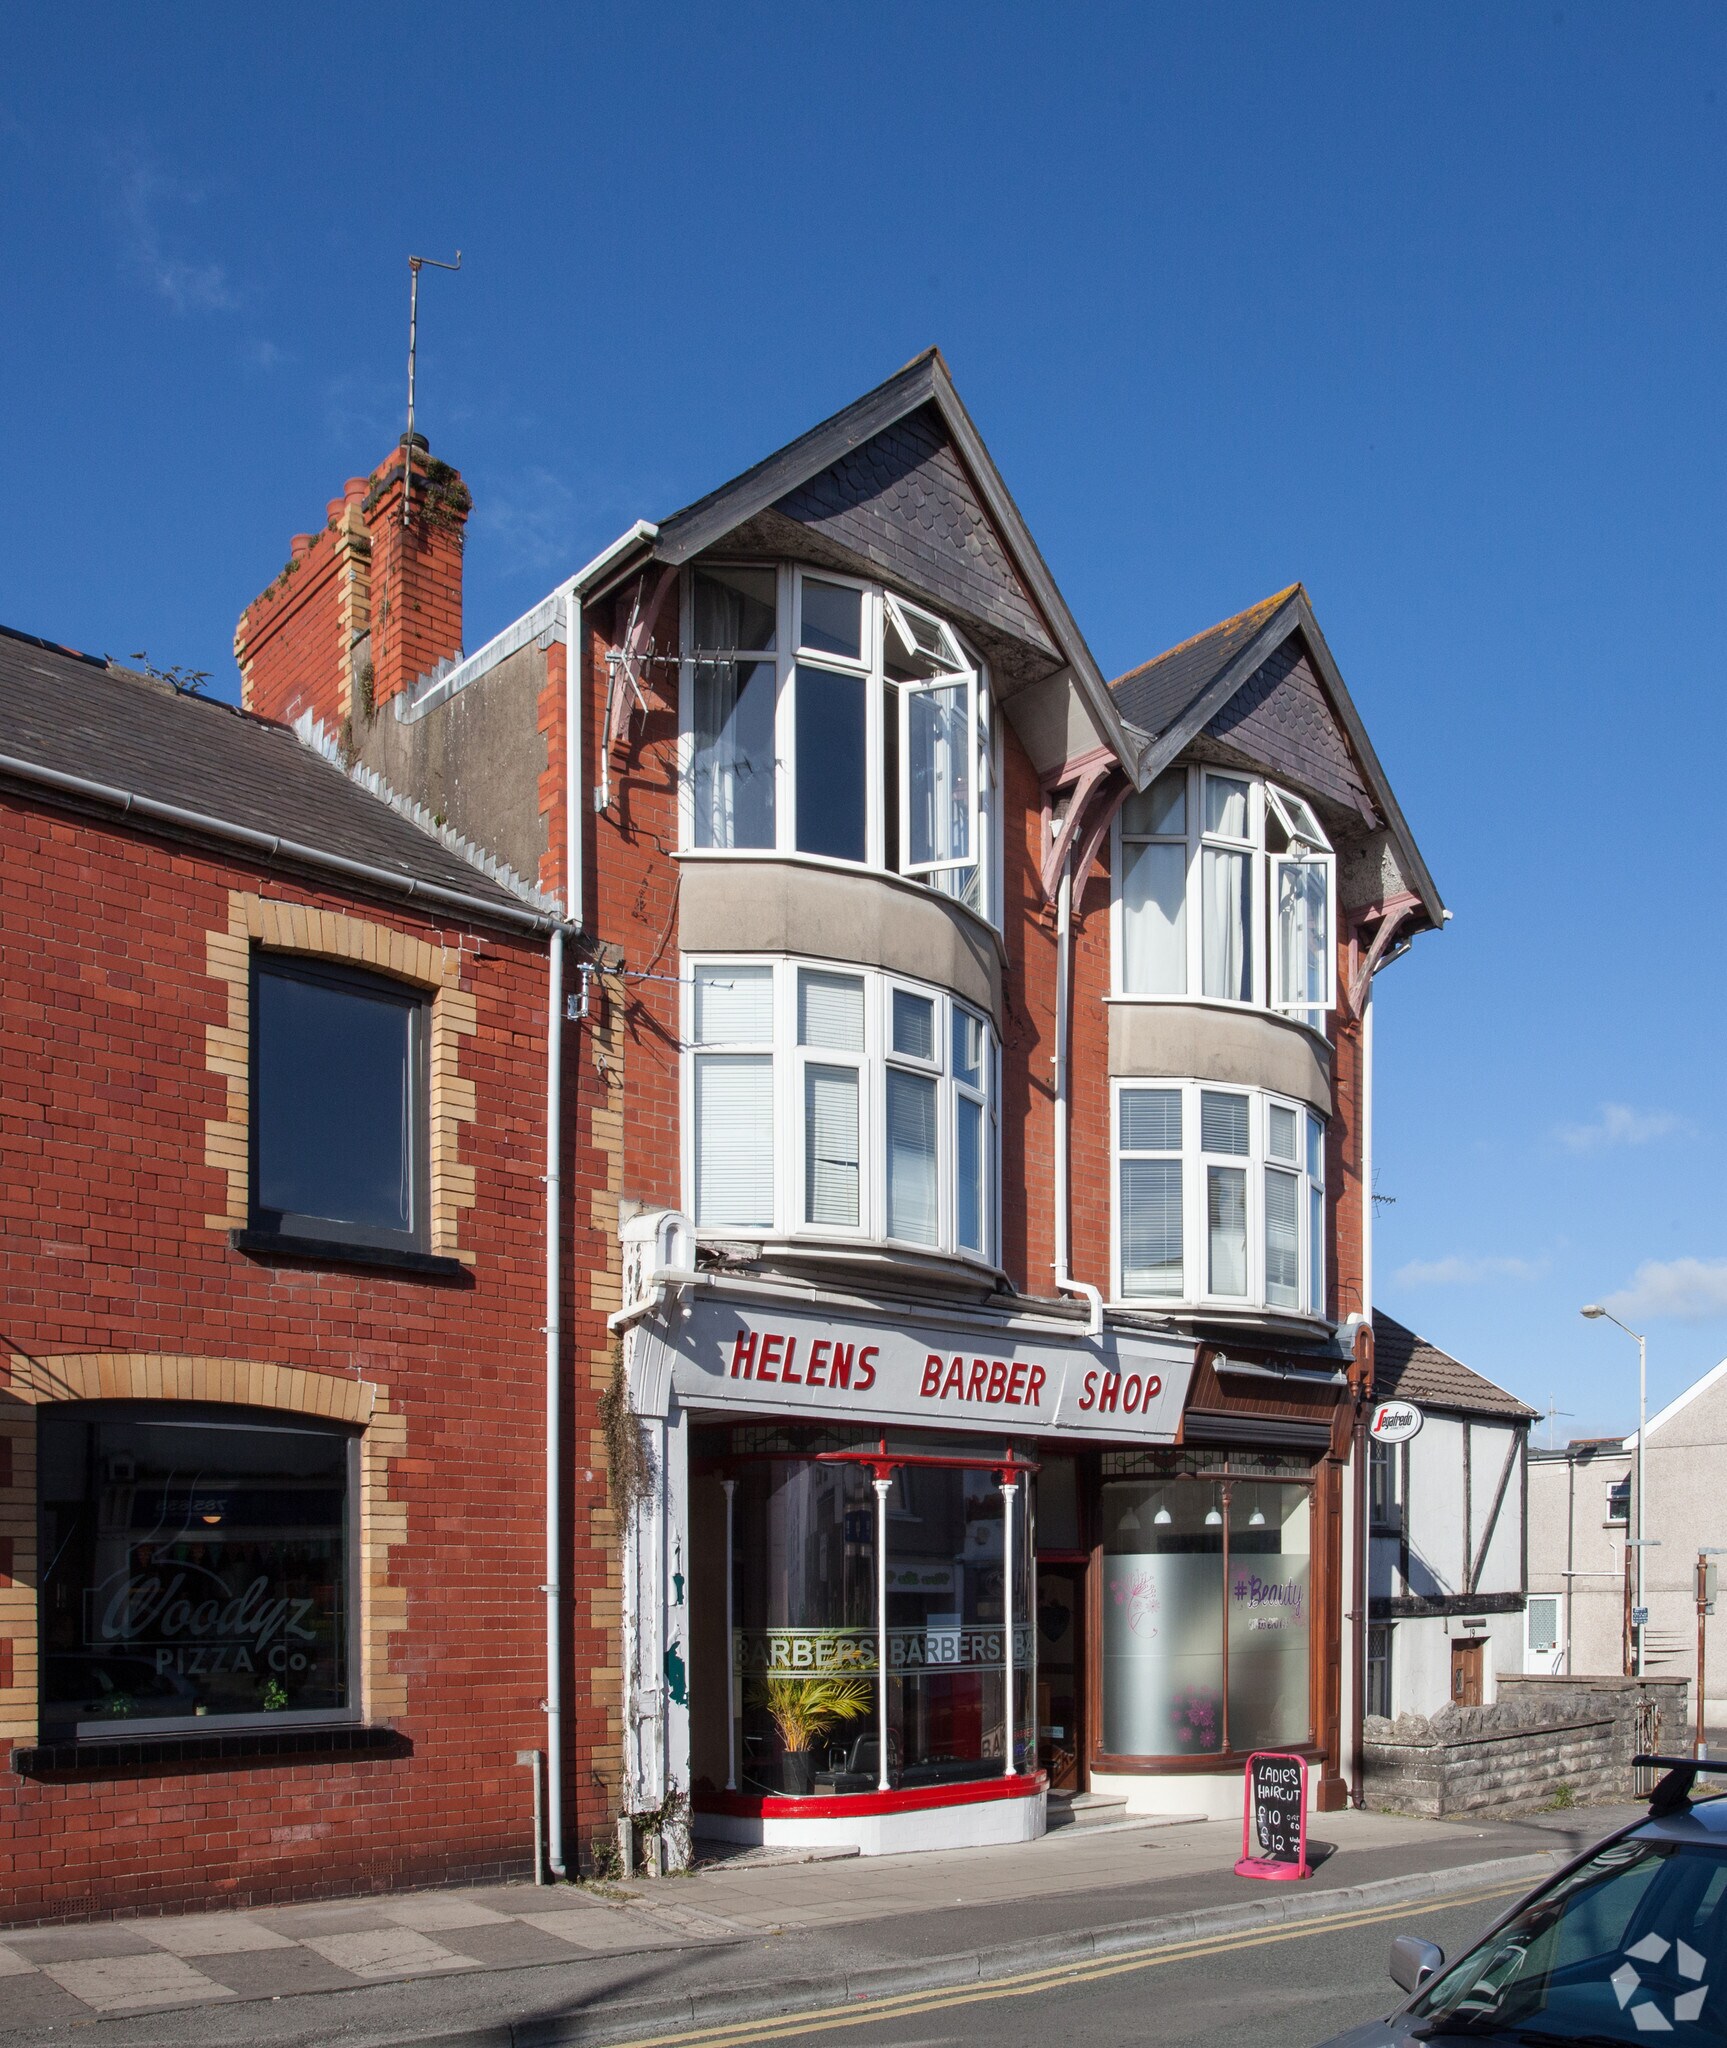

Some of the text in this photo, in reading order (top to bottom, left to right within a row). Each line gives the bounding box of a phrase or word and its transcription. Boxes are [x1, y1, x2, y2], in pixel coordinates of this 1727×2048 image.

[730, 1330, 1163, 1415] HELENS BARBER SHOP
[1373, 1408, 1413, 1432] Segafredo
[1234, 1575, 1303, 1615] #Beauty
[102, 1573, 317, 1653] Woodyz
[157, 1645, 318, 1674] PIZZA Co.
[737, 1639, 875, 1666] BARBERS
[890, 1635, 1000, 1665] BARBERS
